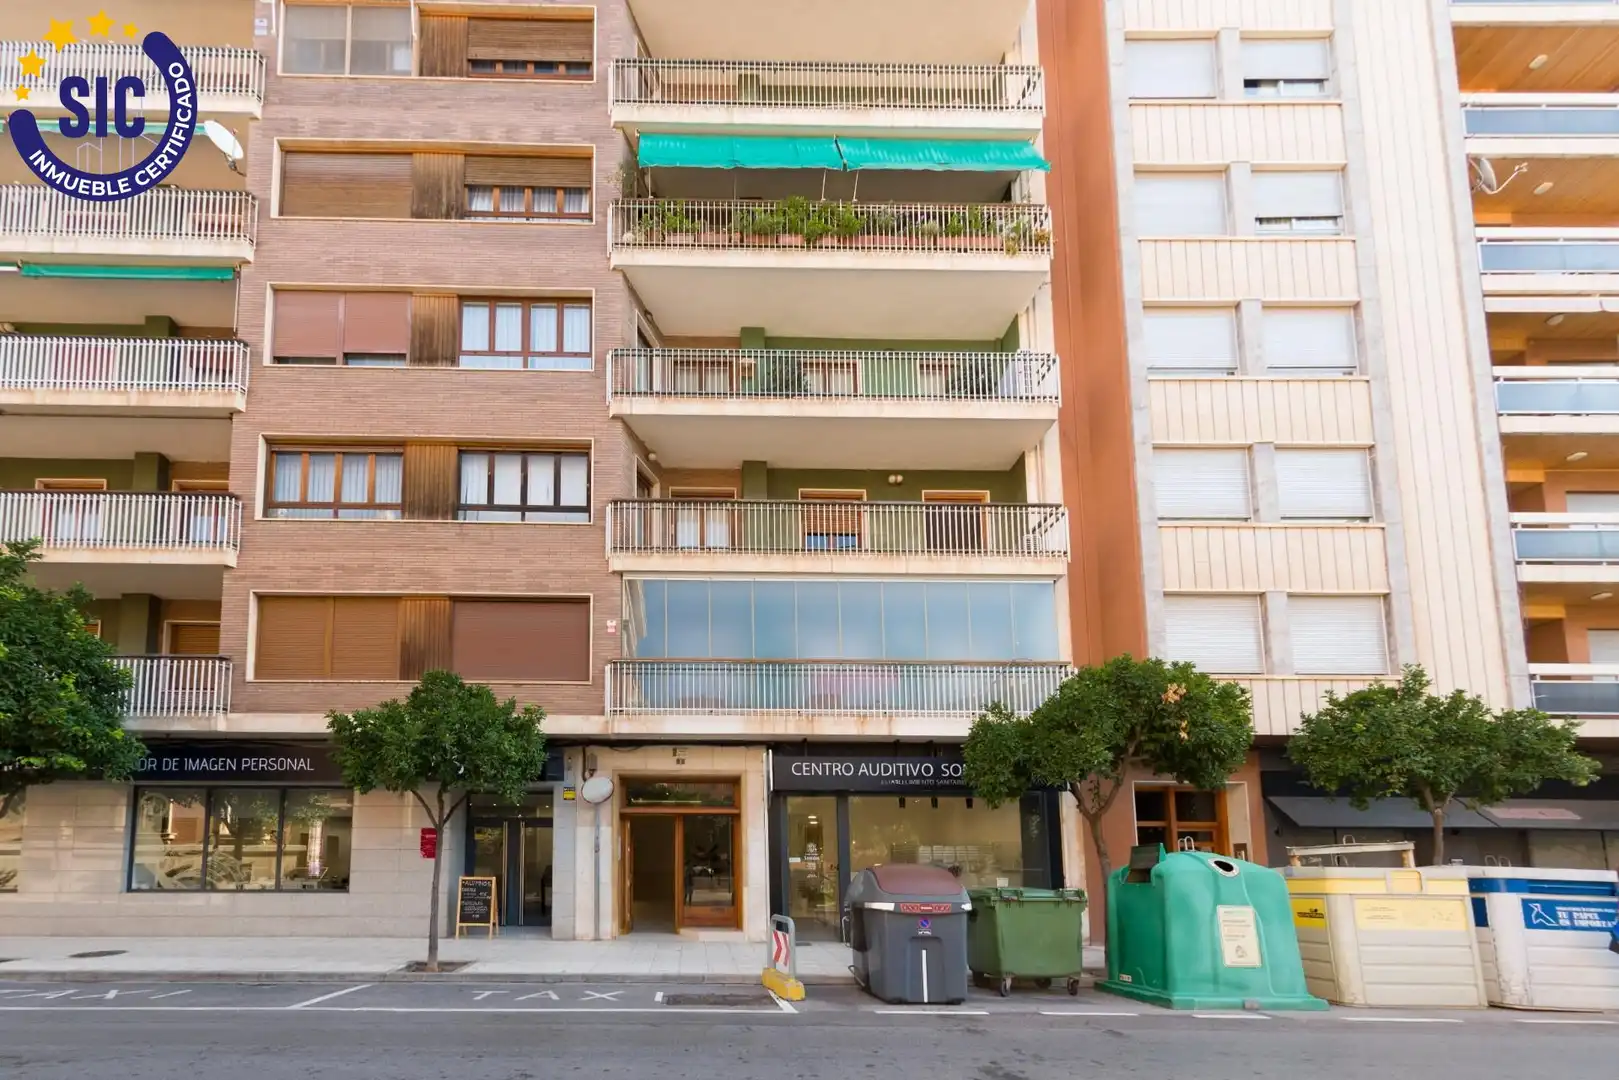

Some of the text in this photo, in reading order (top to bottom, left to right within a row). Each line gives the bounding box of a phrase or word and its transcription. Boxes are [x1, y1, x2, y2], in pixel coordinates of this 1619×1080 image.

[162, 757, 180, 772] DE
[184, 757, 236, 772] IMAGEN
[241, 757, 314, 772] PERSONAL
[791, 762, 854, 777] CENTRO
[858, 762, 934, 777] AUDITIVO
[472, 990, 664, 1002] TAXI
